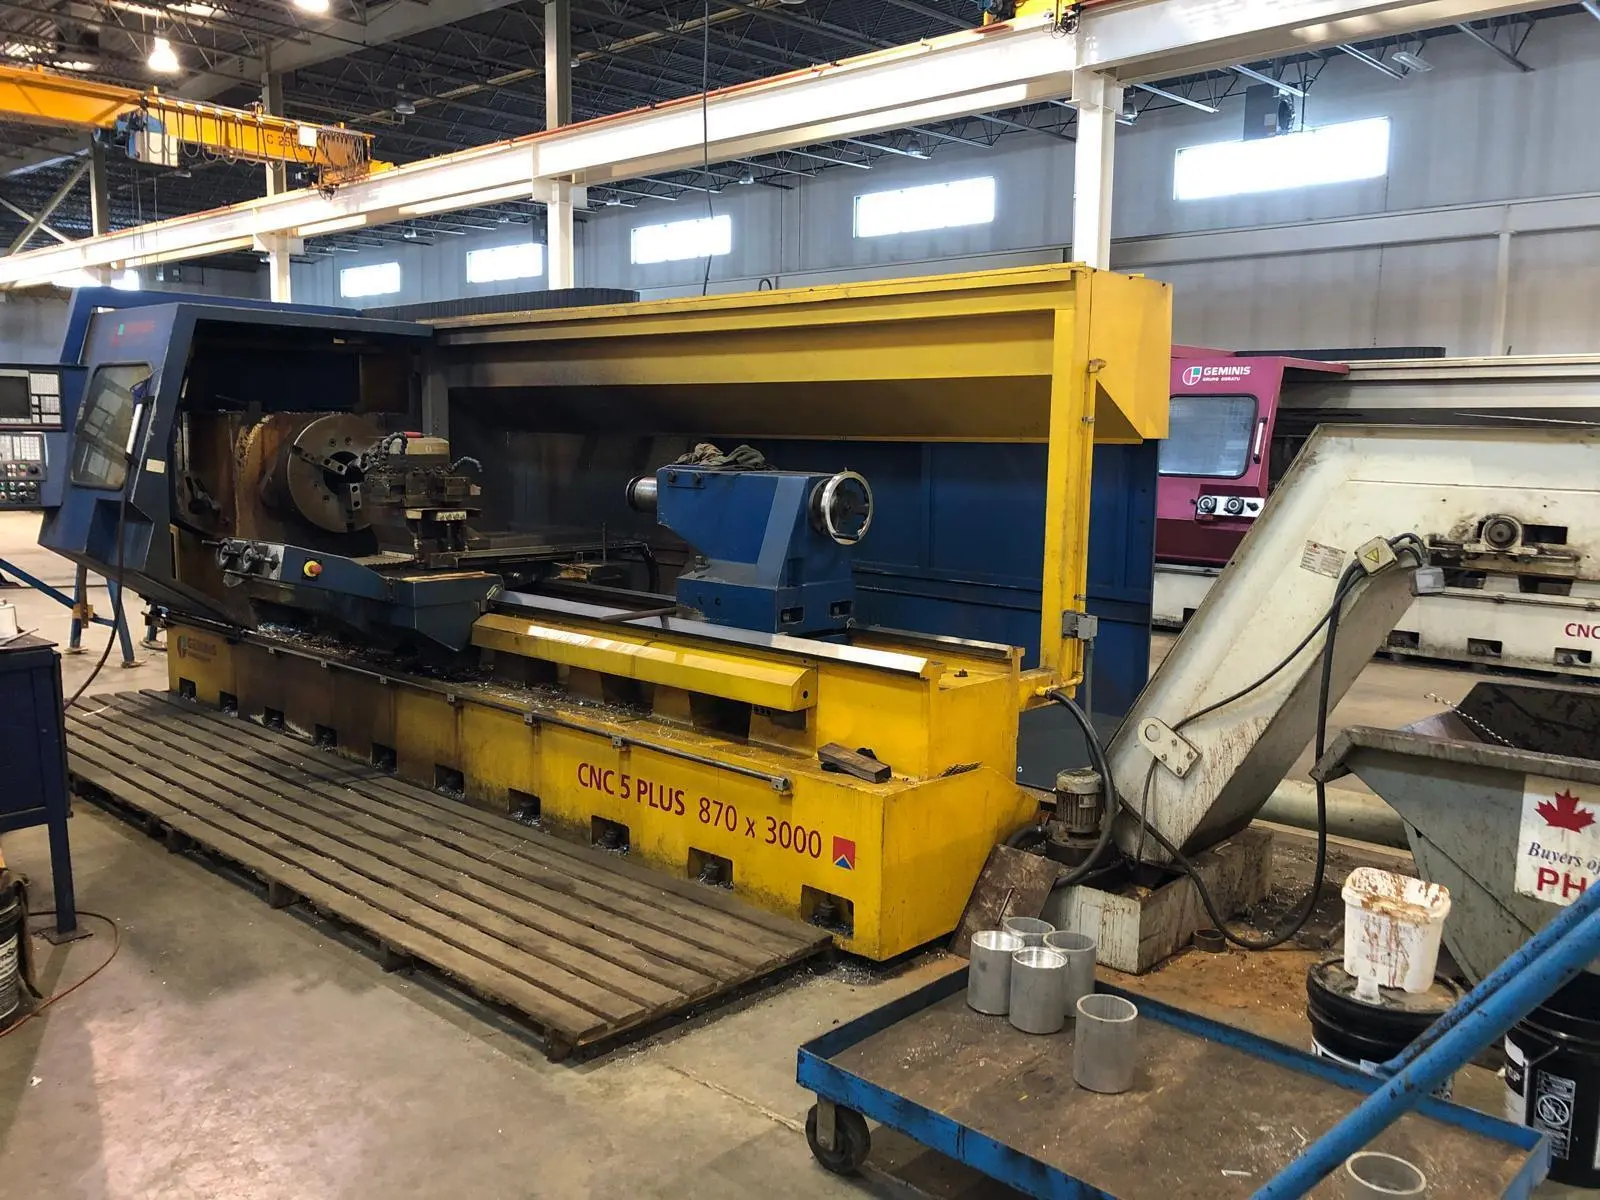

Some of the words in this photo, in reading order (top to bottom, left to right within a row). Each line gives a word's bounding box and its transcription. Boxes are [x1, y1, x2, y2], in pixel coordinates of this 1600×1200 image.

[1203, 366, 1252, 376] GEMINIS
[577, 762, 615, 796] CNC
[620, 775, 631, 800] 5
[636, 779, 686, 816] PLUS
[698, 796, 738, 832] 870
[745, 816, 756, 839] x
[764, 816, 822, 859] 3000
[1528, 842, 1582, 865] Buyers
